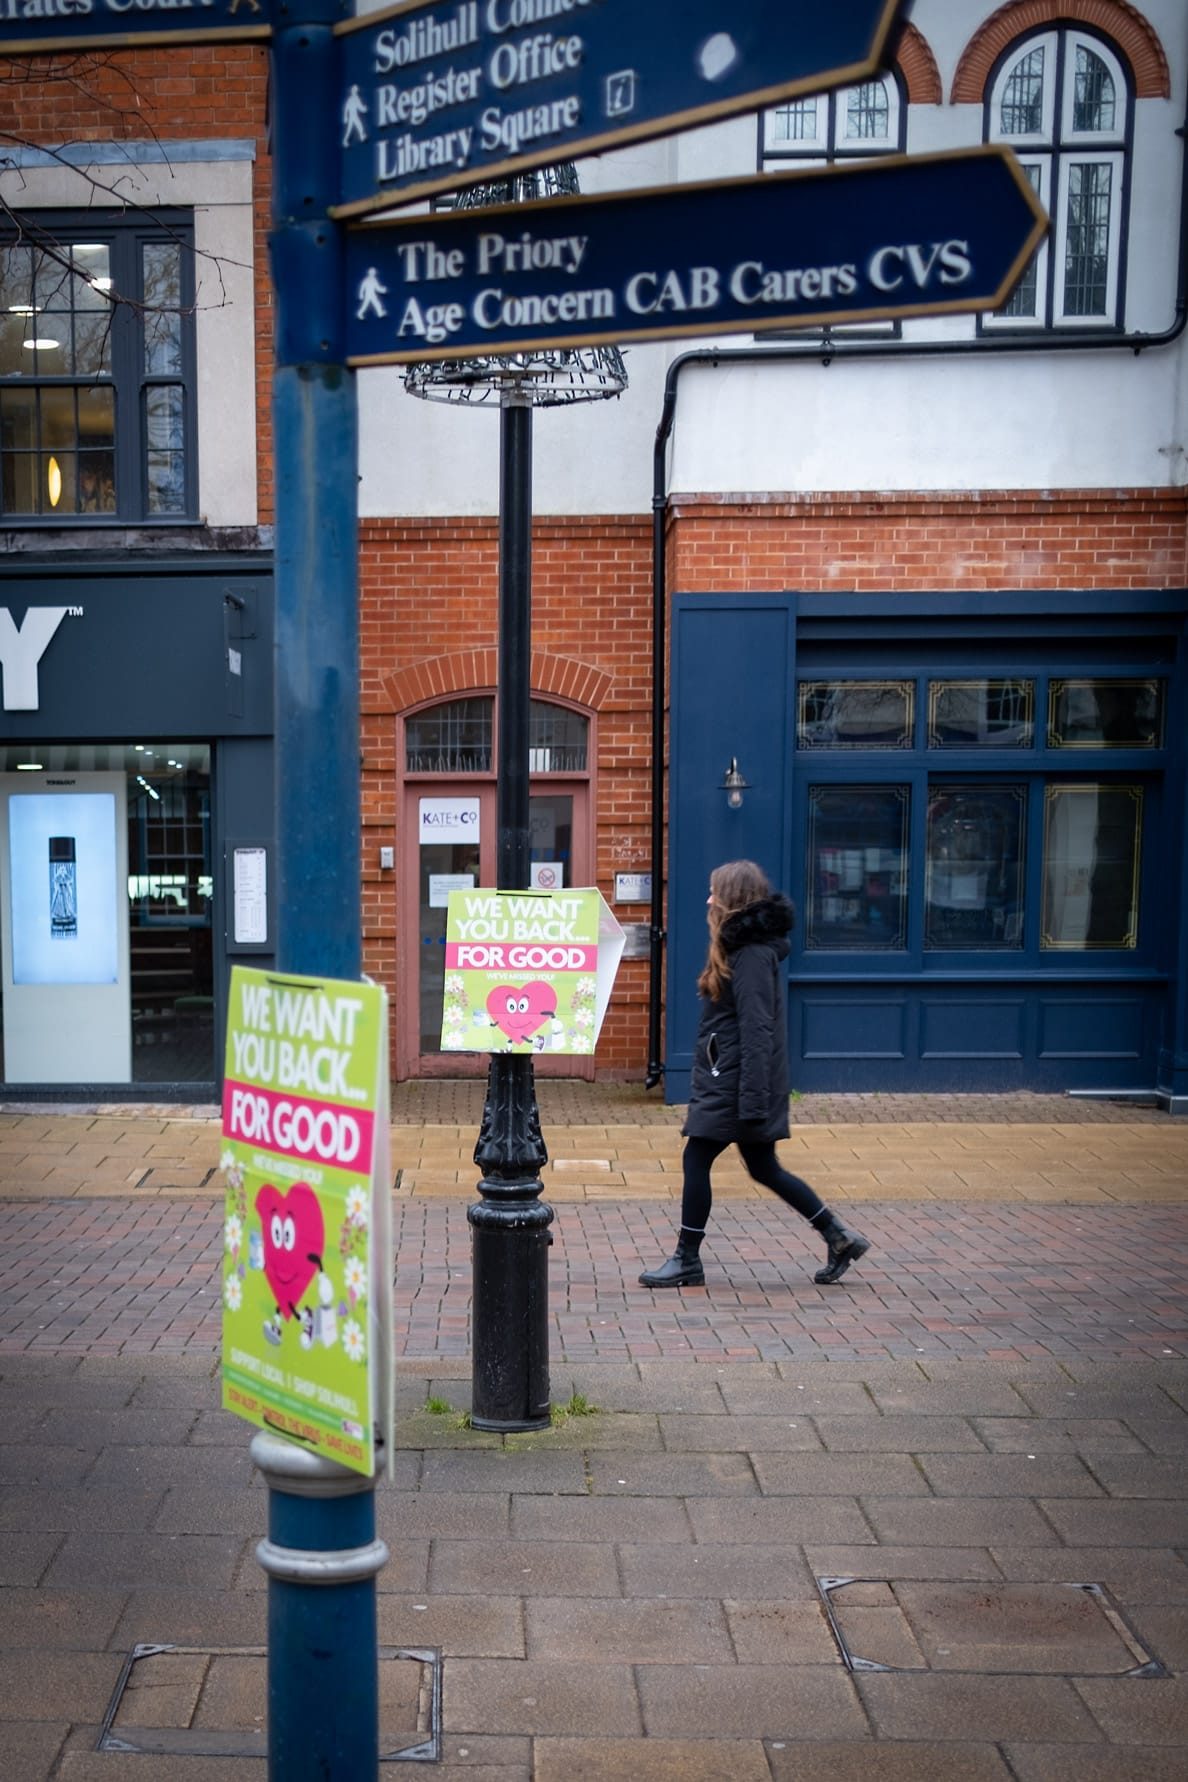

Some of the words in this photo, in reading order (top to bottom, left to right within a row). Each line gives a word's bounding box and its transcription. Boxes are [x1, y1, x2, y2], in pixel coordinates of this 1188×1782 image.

[375, 2, 478, 73] Solihull
[487, 0, 592, 33] Conn
[377, 67, 482, 127] Register
[490, 33, 582, 88] Office
[376, 126, 473, 182] Library
[481, 96, 580, 153] Square
[397, 297, 463, 343] Age
[472, 288, 615, 329] Concern
[625, 266, 720, 314] CAB
[730, 261, 857, 304] Carers
[869, 240, 972, 291] CVS
[398, 242, 464, 282] The
[477, 232, 588, 274] Priory
[455, 919, 510, 940] YOU
[513, 920, 590, 942] BACK...
[464, 897, 503, 918] WE
[507, 897, 583, 919] WANT
[457, 945, 506, 968] FOR
[508, 947, 586, 969] GOOD
[241, 984, 272, 1032] WE
[274, 989, 363, 1046] WANT
[233, 1031, 275, 1081] YOU
[278, 1041, 367, 1101] BACK...
[231, 1090, 271, 1143] FOR
[273, 1101, 360, 1163] GOOD
